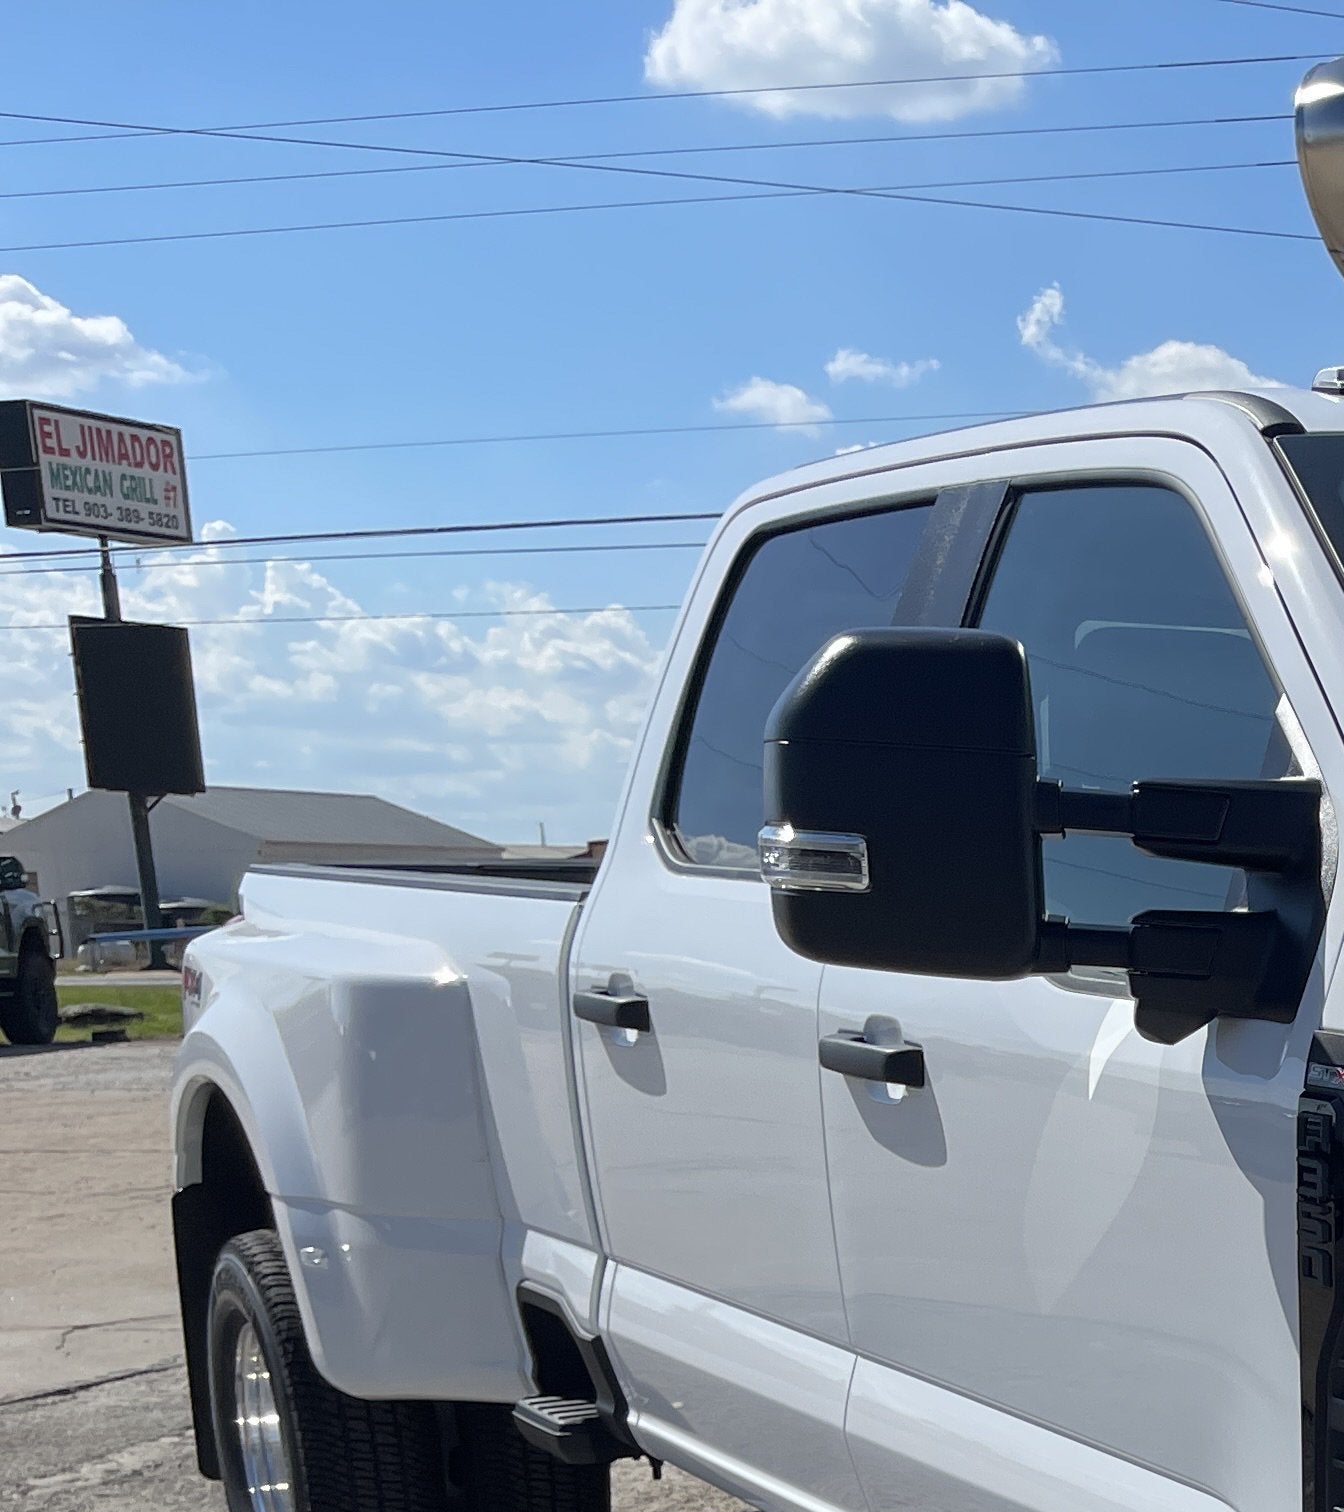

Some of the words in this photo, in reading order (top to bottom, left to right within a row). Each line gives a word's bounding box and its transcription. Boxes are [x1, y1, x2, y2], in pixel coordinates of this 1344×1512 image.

[38, 416, 71, 457] EL
[75, 424, 177, 476] JIMADOR
[48, 461, 114, 498] MEXICAN
[120, 473, 158, 505] GRILL
[52, 497, 80, 515] TEL
[148, 511, 180, 531] 5820
